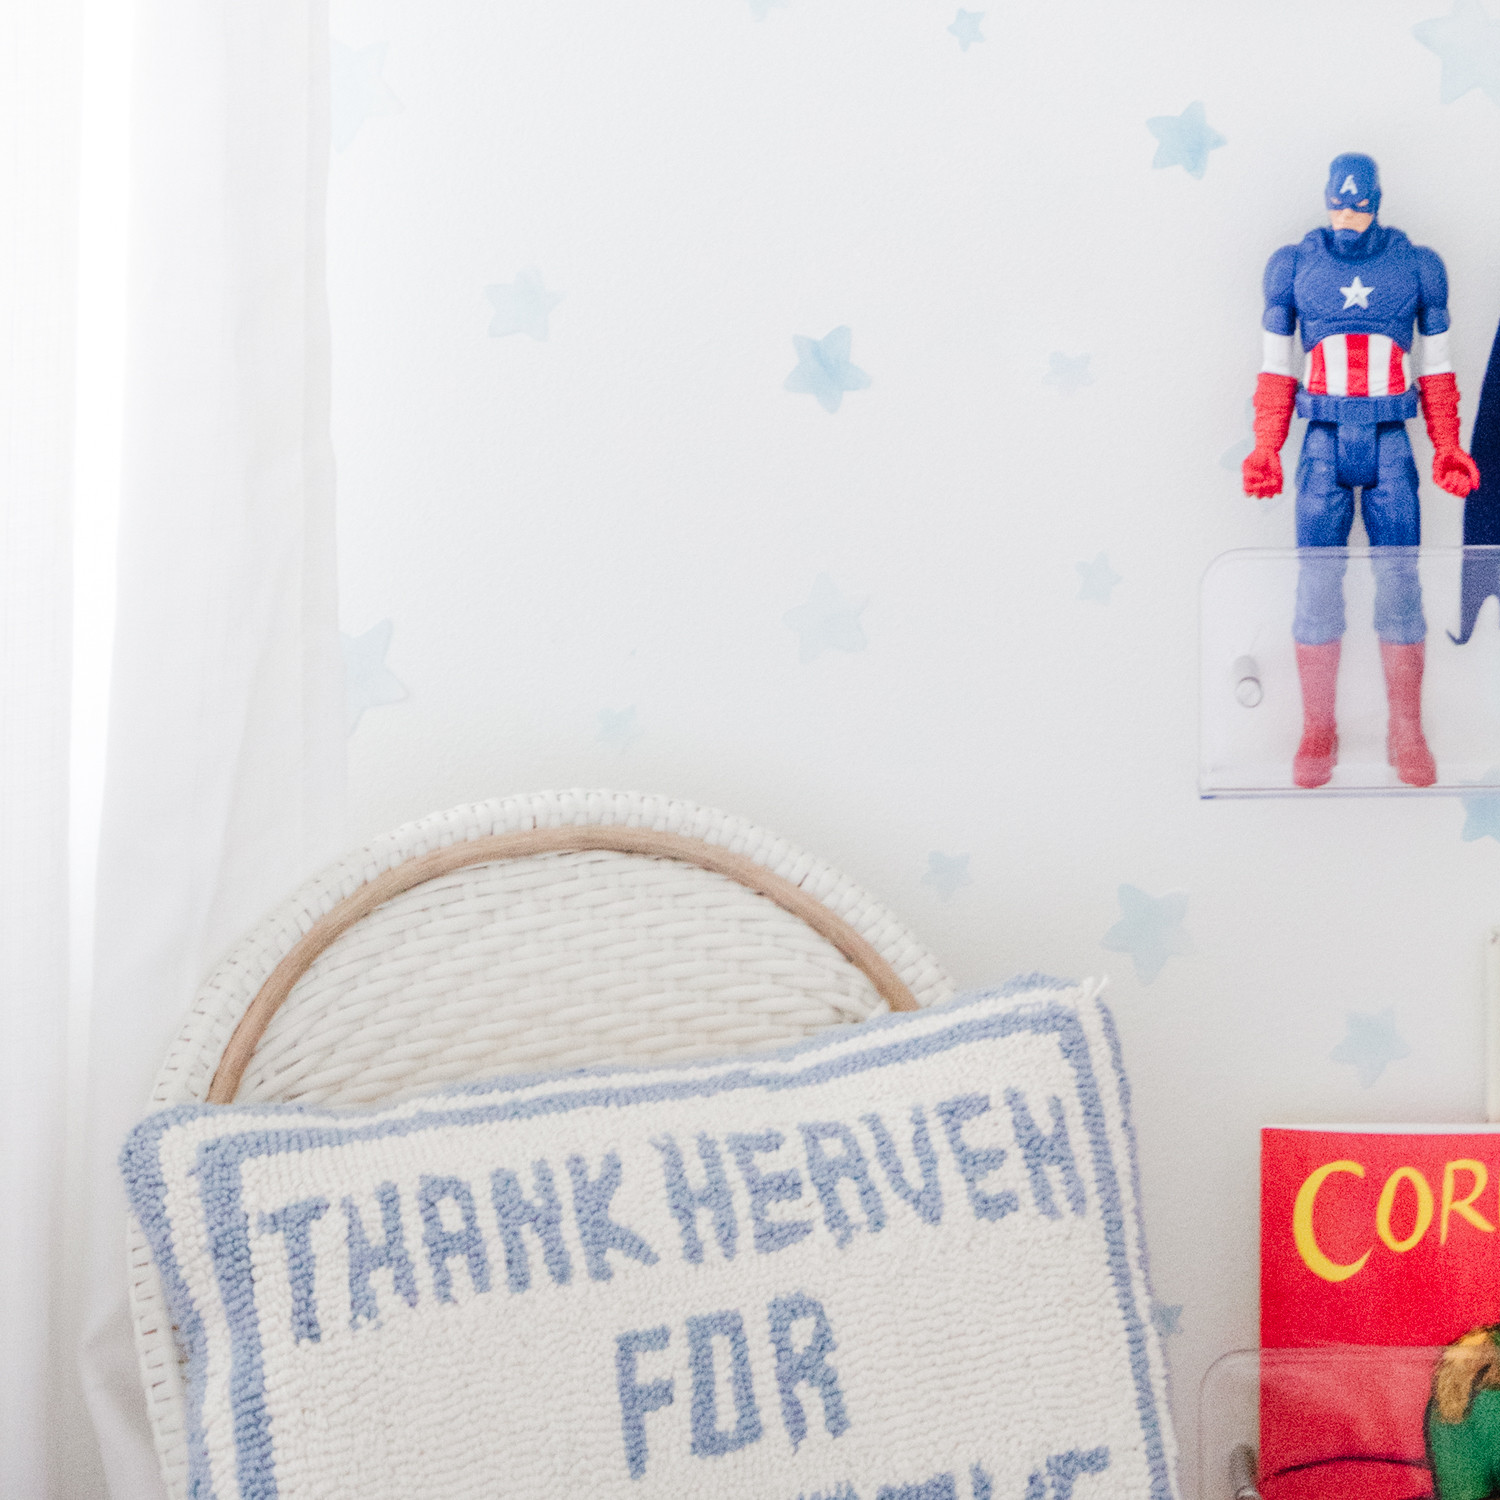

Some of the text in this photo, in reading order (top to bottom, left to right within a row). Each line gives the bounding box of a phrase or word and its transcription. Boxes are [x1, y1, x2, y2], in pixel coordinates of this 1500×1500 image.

[1339, 174, 1358, 195] A
[257, 1151, 659, 1344] THANK
[615, 1290, 852, 1480] FOR
